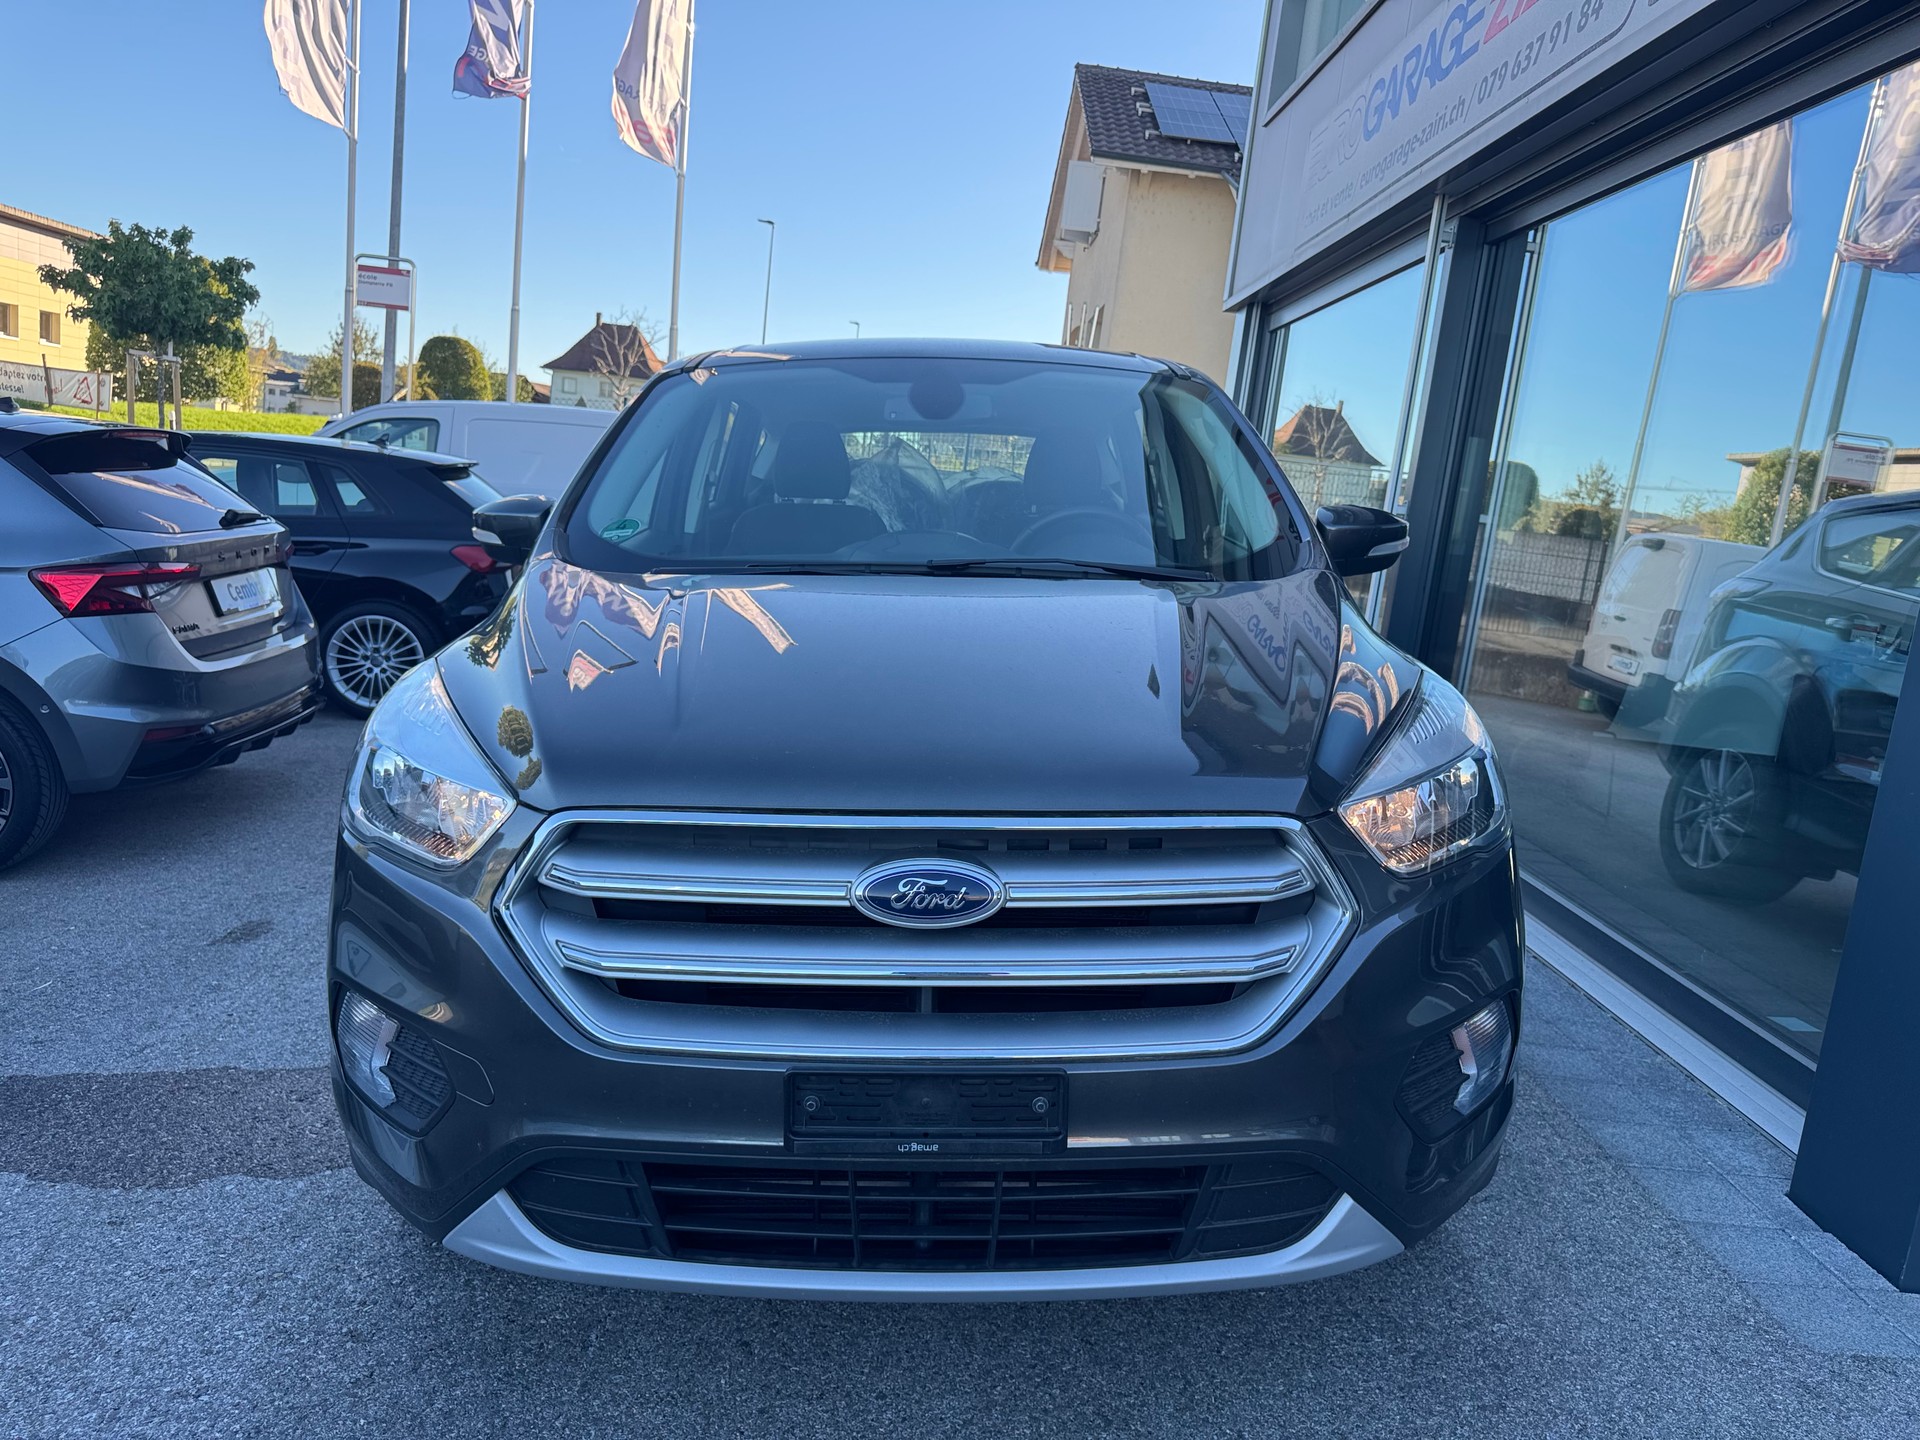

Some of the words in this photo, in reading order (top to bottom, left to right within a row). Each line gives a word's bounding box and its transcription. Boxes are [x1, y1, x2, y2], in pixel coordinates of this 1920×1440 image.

[1359, 94, 1467, 190] eurogarage-zairi.ch
[1477, 60, 1509, 105] 079
[1510, 31, 1547, 82] 637
[1549, 10, 1573, 55] 91
[1576, 0, 1605, 34] 84
[891, 877, 967, 909] Ford
[897, 1142, 939, 1153] amag.ch
